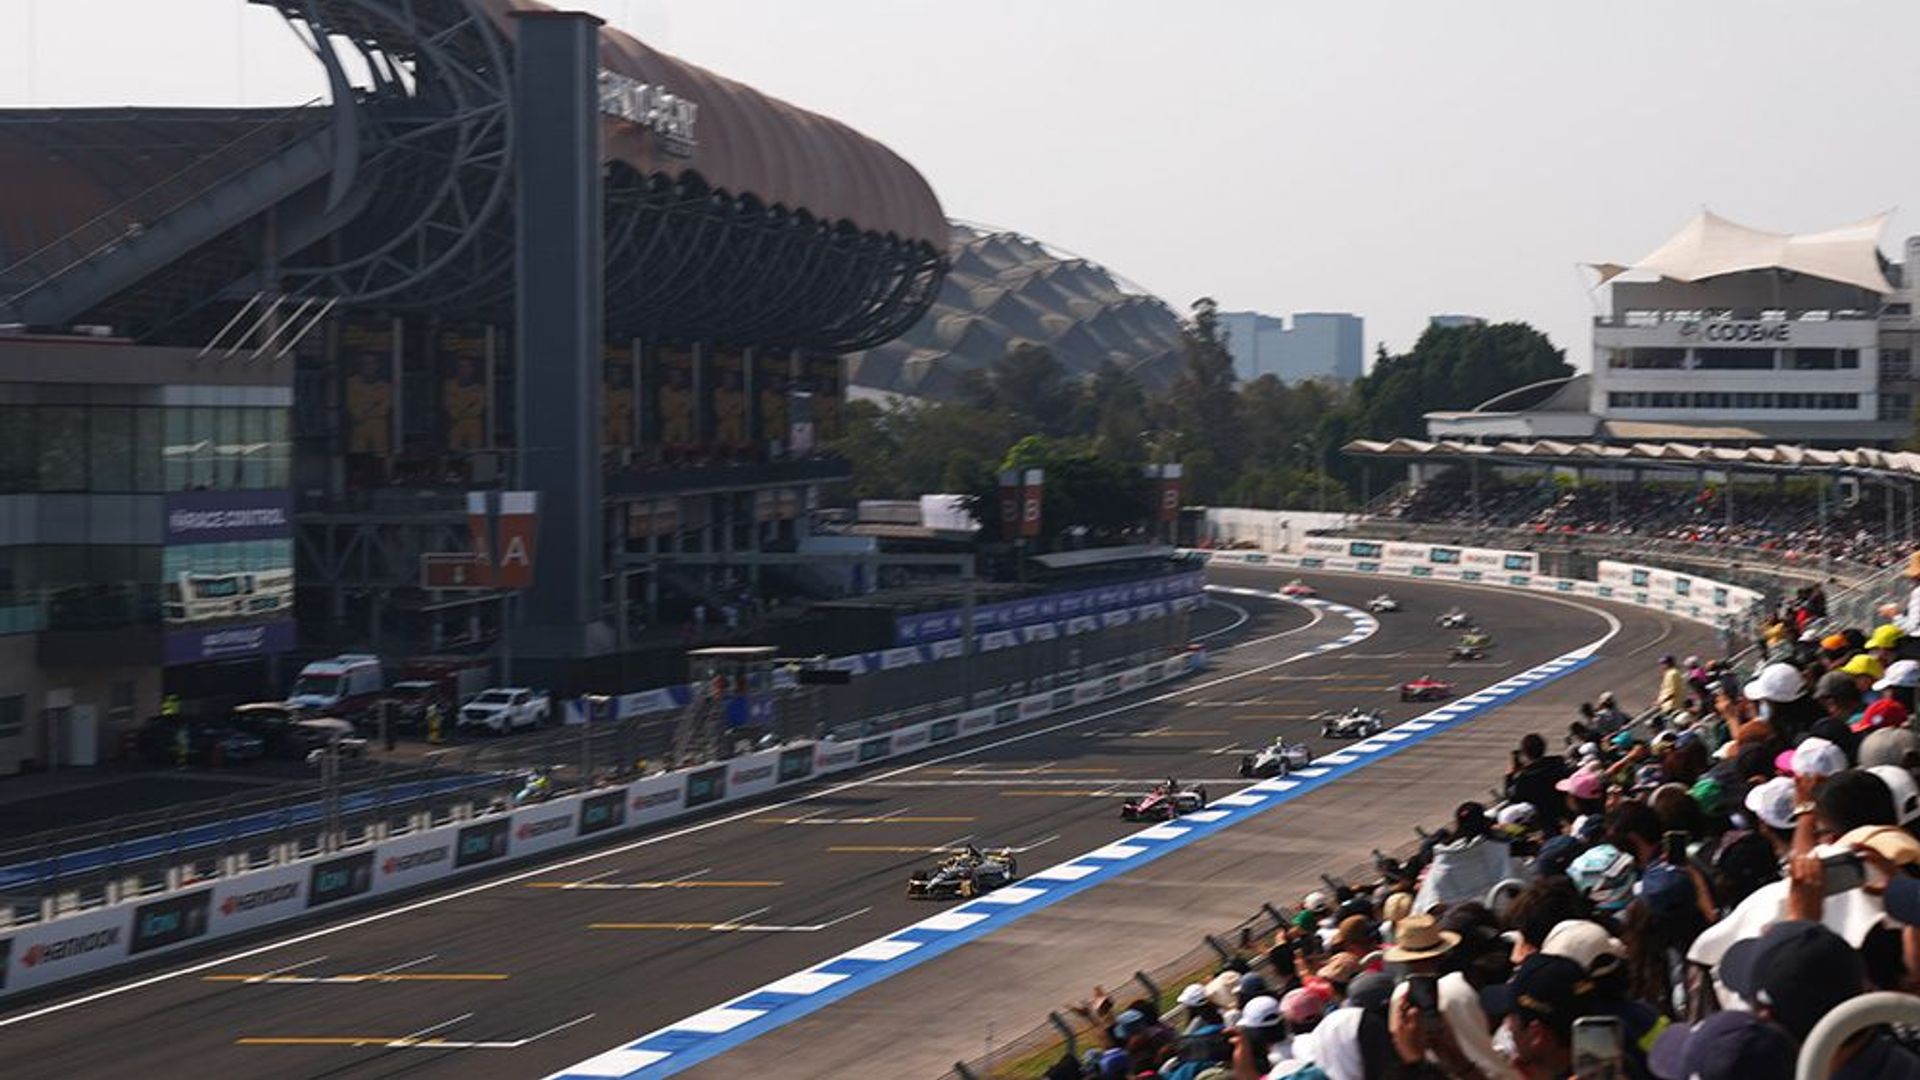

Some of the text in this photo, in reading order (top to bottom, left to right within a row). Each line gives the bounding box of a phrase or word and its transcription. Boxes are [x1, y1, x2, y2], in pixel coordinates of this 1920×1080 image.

[1705, 323, 1789, 342] CODEME
[187, 510, 224, 529] RACE
[226, 508, 287, 527] CONTROL
[500, 535, 530, 568] A
